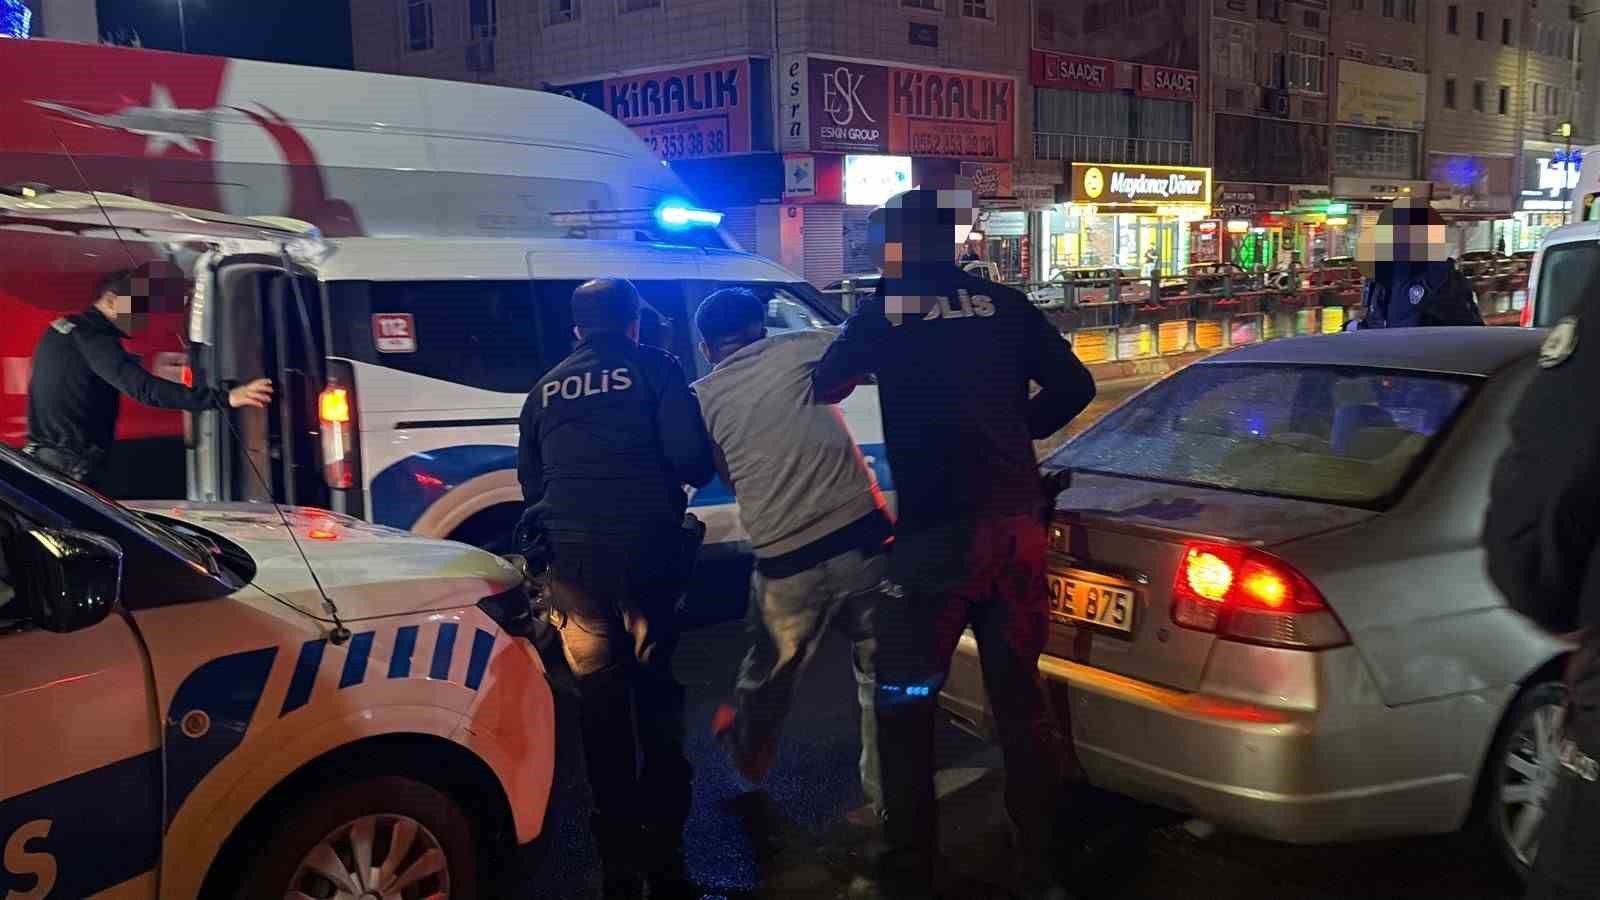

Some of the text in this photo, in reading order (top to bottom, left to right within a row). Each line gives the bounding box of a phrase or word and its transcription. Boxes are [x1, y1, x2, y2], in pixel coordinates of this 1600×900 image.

[1060, 61, 1105, 86] SAADET
[1154, 71, 1199, 97] SAADET
[848, 128, 880, 141] GROUP
[1086, 587, 1128, 625] 875
